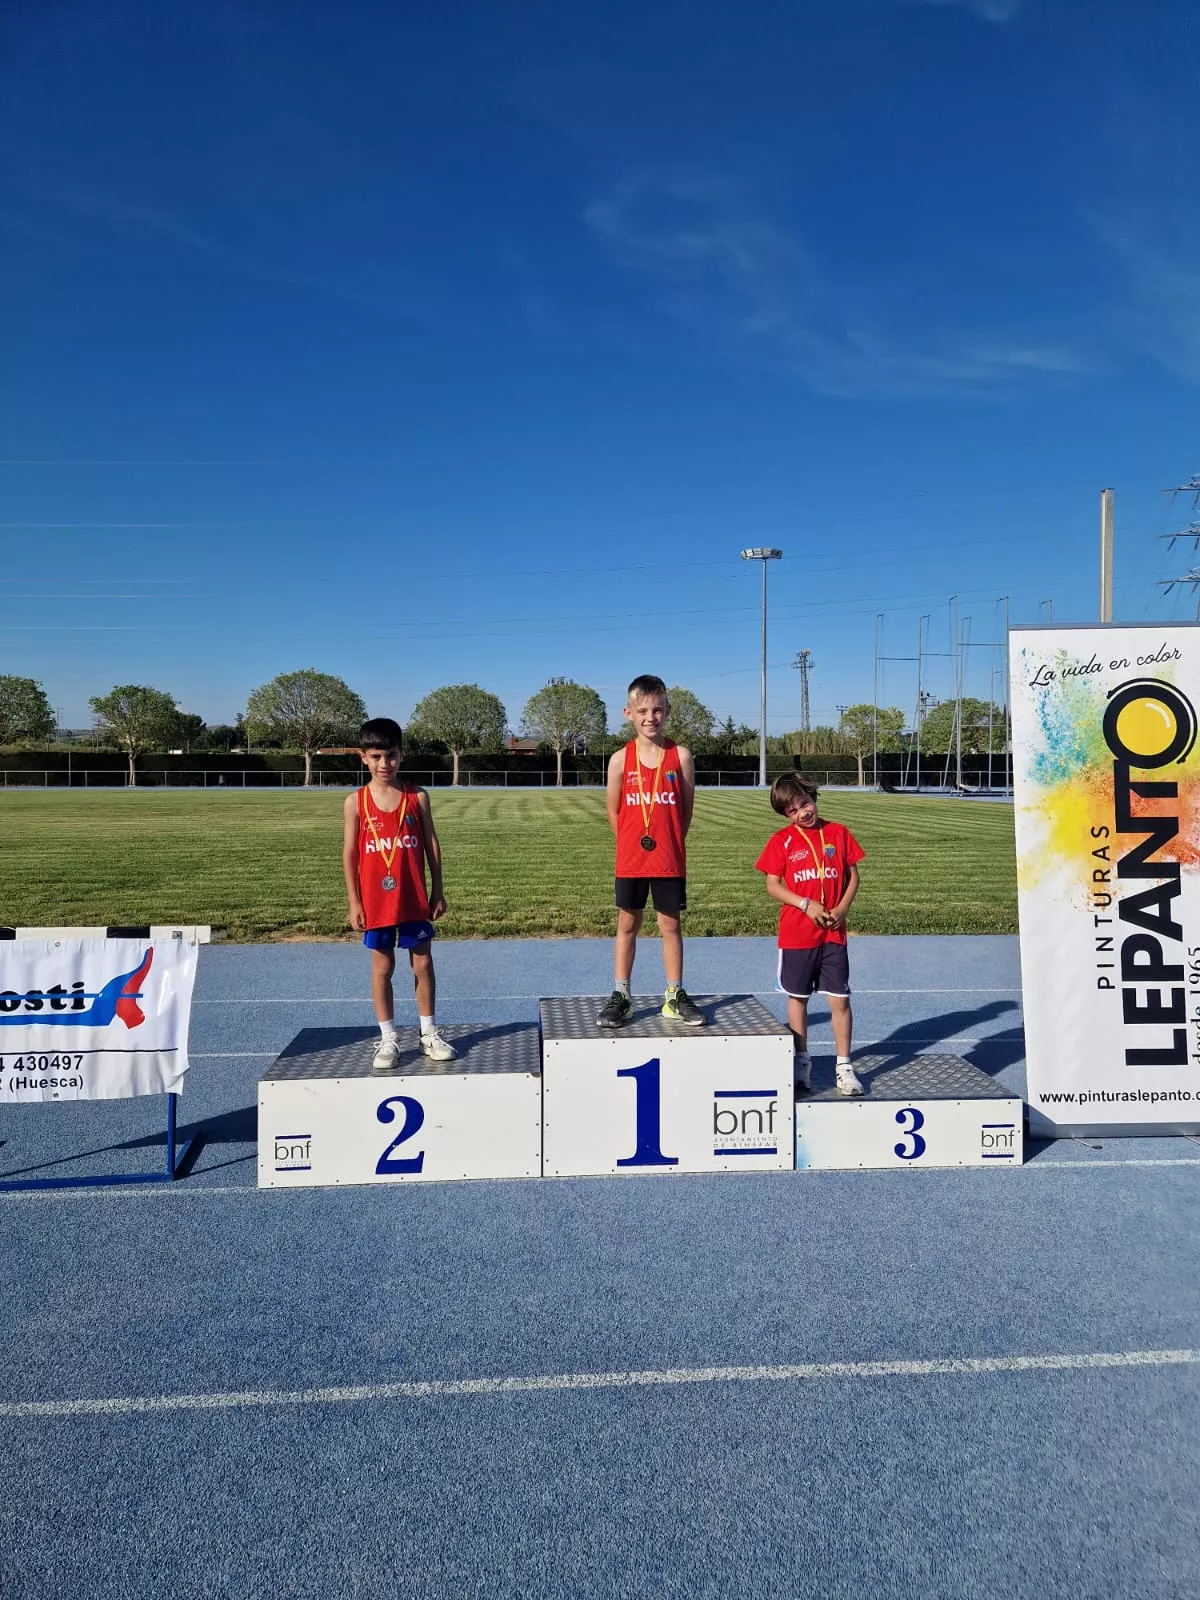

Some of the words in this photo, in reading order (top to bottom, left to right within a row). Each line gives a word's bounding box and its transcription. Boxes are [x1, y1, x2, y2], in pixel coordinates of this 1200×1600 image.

[1029, 664, 1056, 687] La
[1062, 653, 1103, 678] vida
[1109, 657, 1131, 671] en
[1137, 642, 1184, 666] color
[1091, 825, 1115, 990] PINTURAS
[9, 1074, 84, 1092] (Huesca)
[13, 1055, 84, 1072] 430497
[617, 1058, 680, 1166] 1
[713, 1101, 777, 1135] bnf
[274, 1140, 312, 1160] bnf
[375, 1095, 425, 1175] 2
[893, 1107, 927, 1160] 3
[981, 1129, 1015, 1148] bnf
